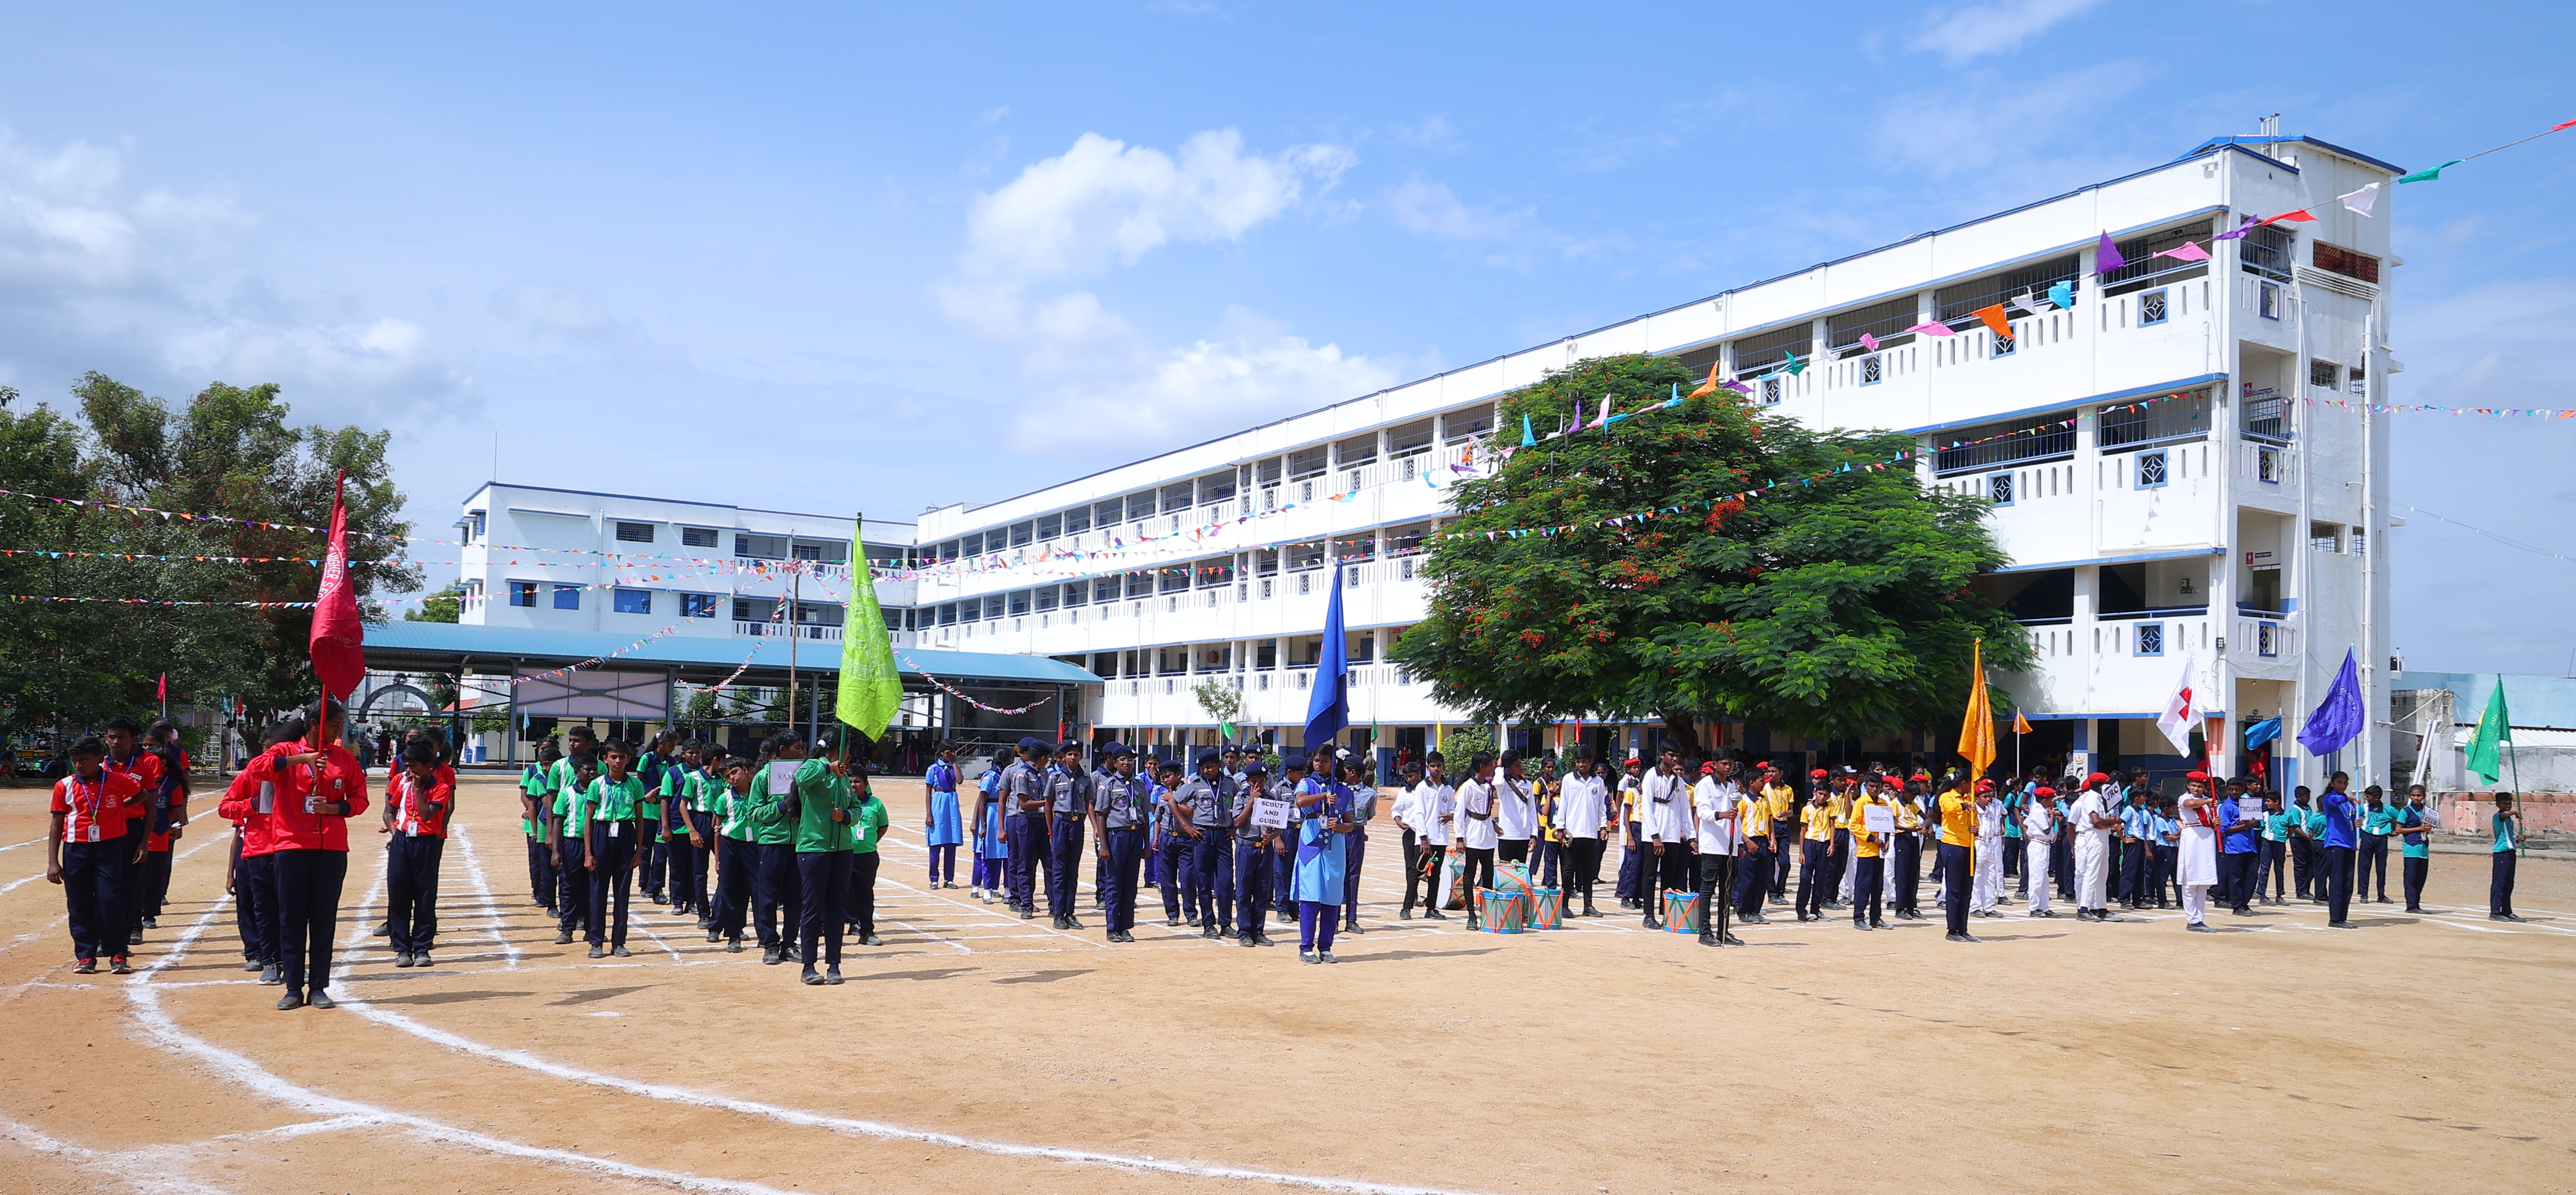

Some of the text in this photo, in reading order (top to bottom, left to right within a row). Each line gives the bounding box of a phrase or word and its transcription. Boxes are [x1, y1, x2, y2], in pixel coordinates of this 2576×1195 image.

[326, 552, 341, 580] HIGHER
[2107, 785, 2119, 801] JRC
[2425, 817, 2437, 825] CLUB
